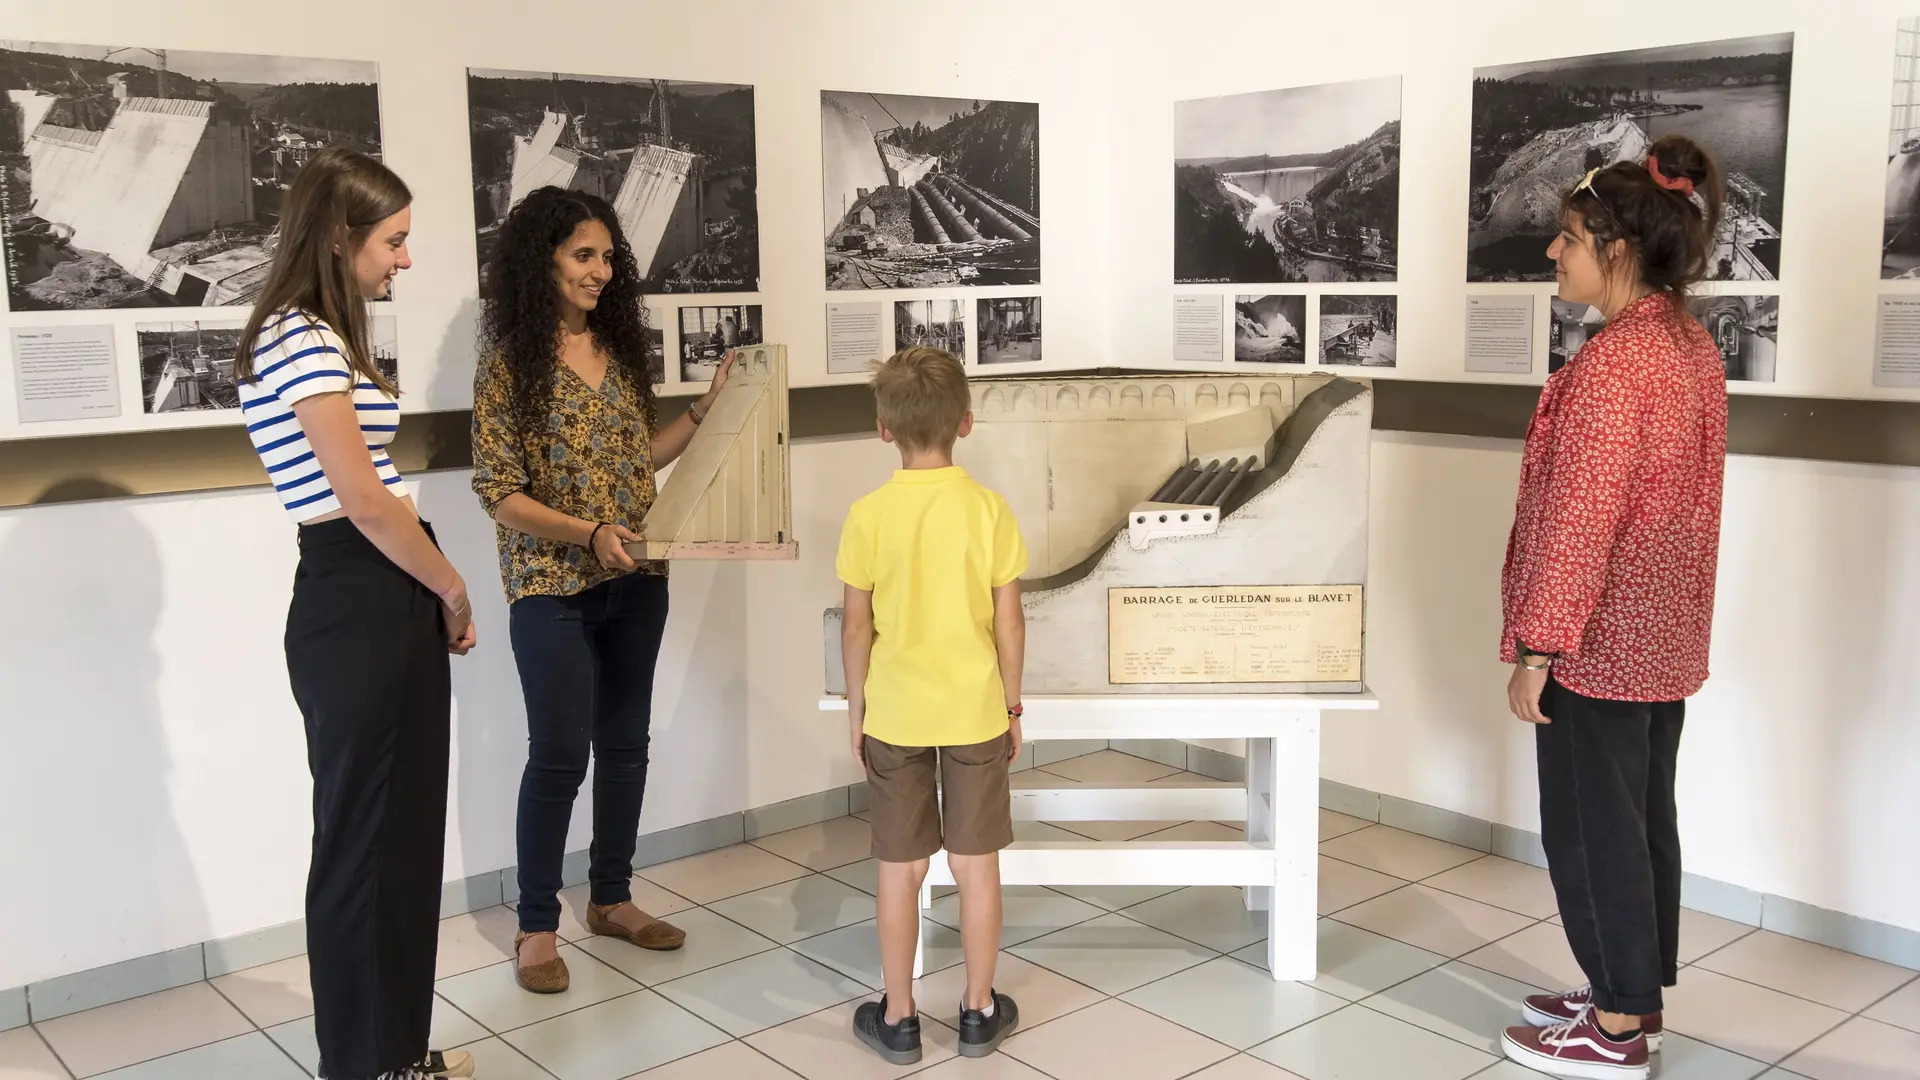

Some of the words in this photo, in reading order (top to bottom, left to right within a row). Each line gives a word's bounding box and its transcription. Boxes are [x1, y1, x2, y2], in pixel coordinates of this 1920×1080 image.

[1123, 595, 1183, 605] BARRAGE
[1202, 595, 1271, 604] GUERLEDAN
[1308, 593, 1353, 603] BLAVET
